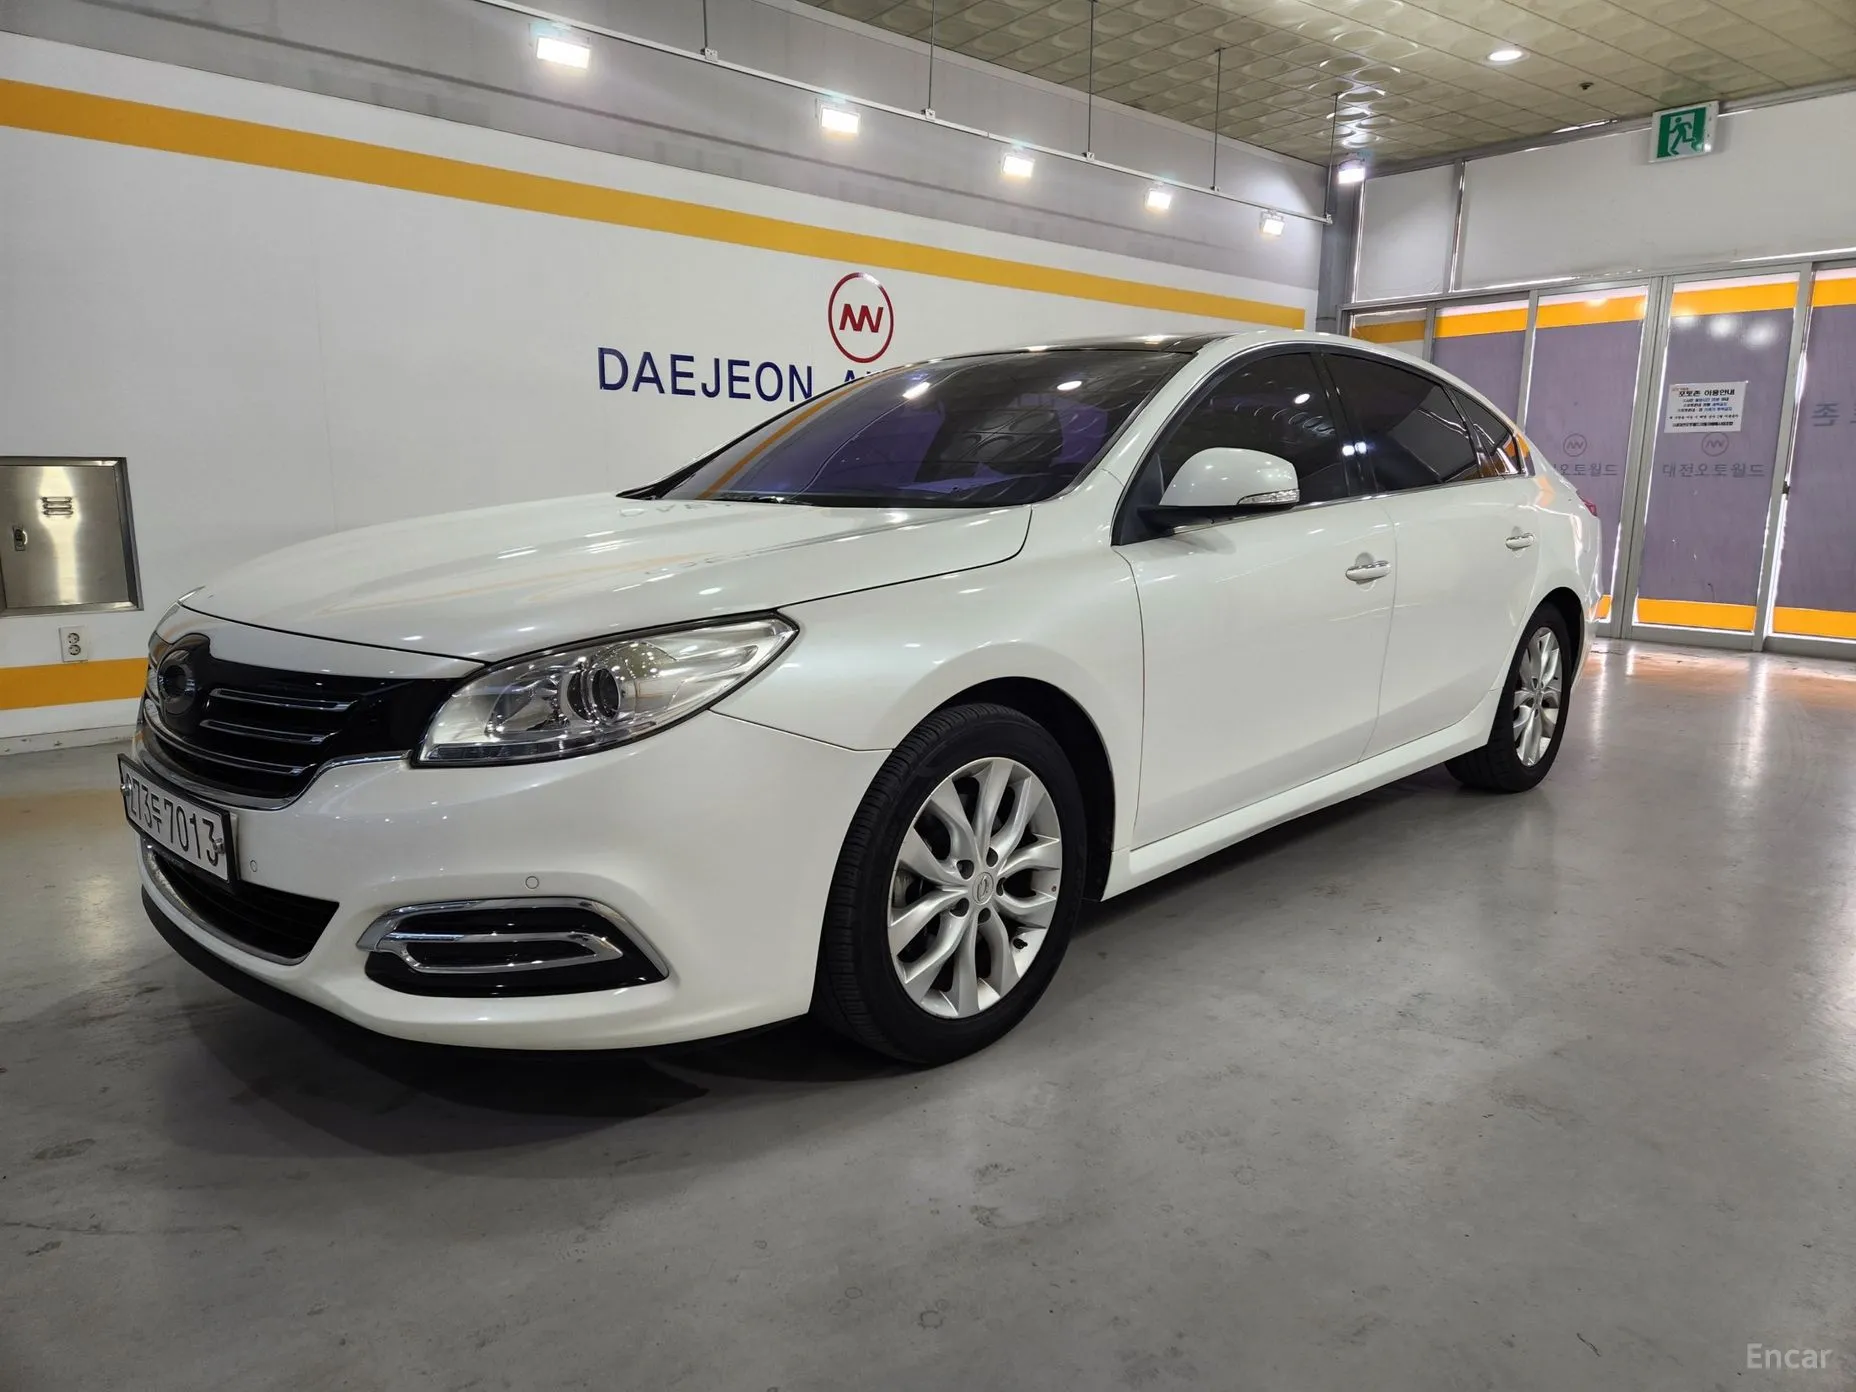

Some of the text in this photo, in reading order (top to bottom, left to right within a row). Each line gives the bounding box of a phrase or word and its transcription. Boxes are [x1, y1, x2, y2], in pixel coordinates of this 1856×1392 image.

[598, 347, 813, 402] DAEJEON
[1704, 388, 1735, 397] 이용안내
[1554, 462, 1618, 478] 오토월드
[1662, 462, 1765, 478] 대전오토월드
